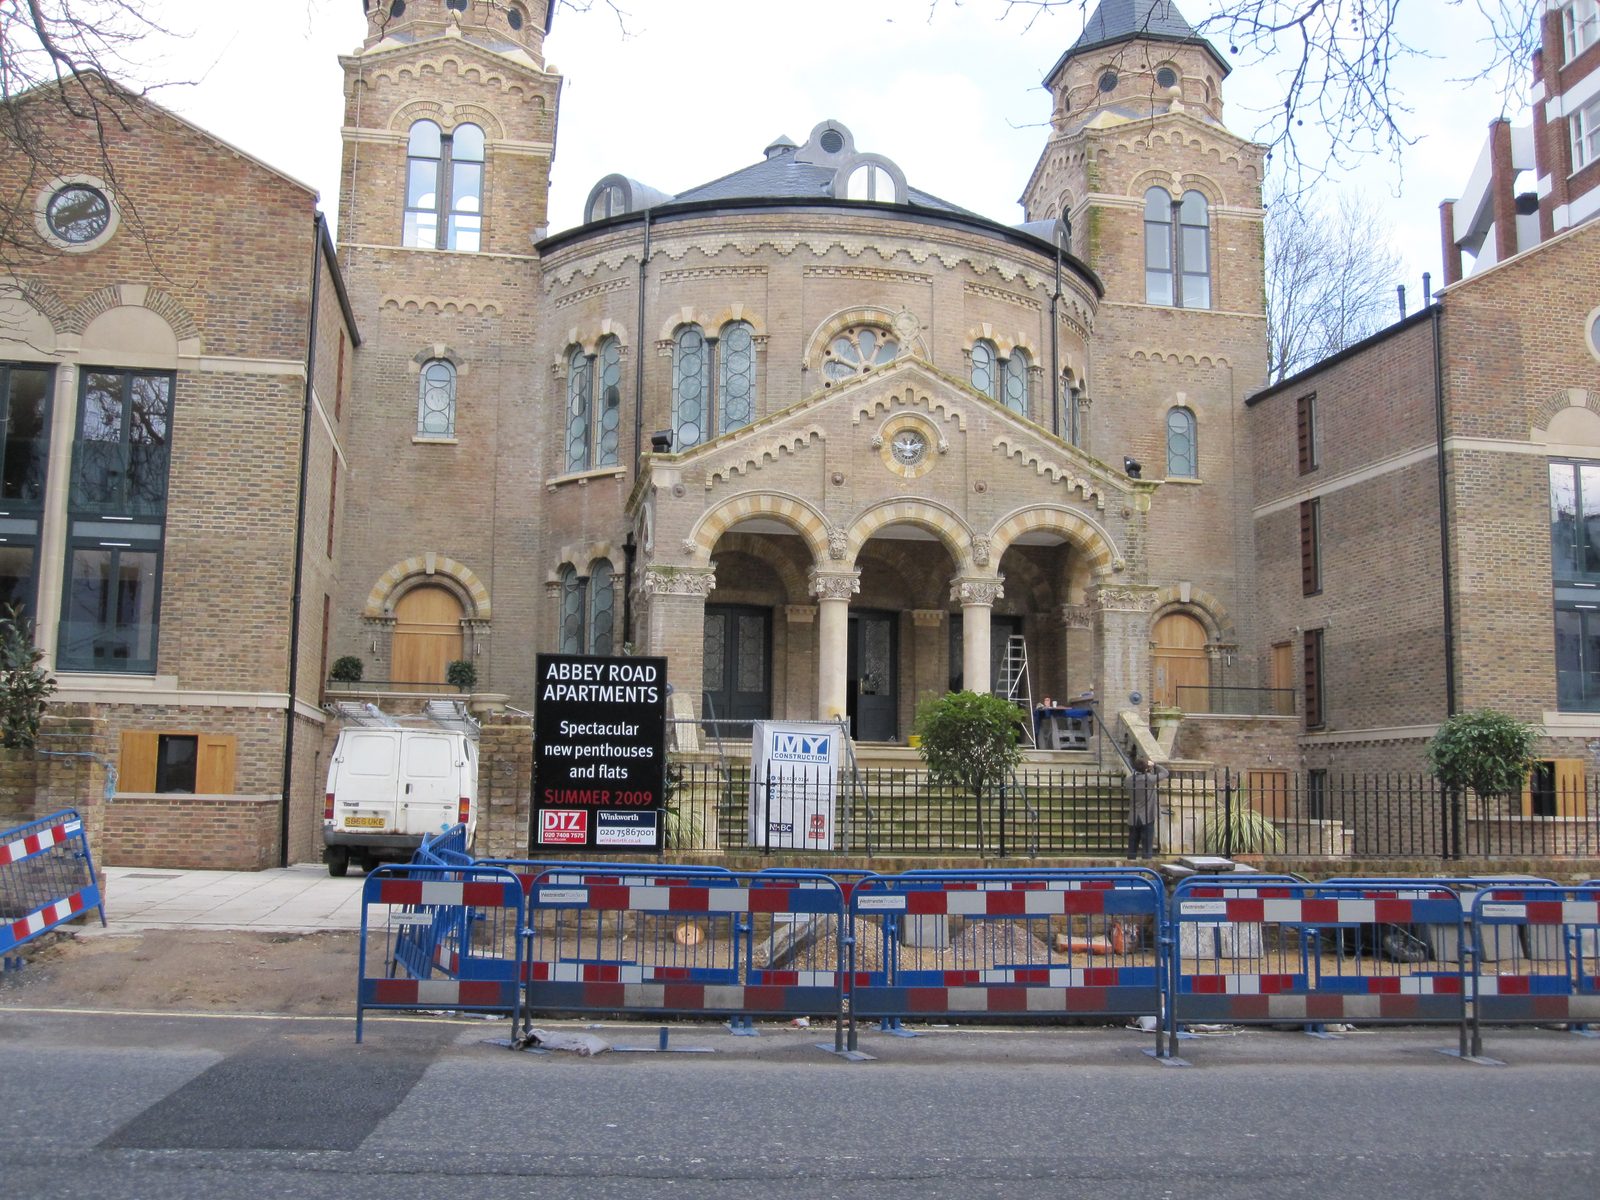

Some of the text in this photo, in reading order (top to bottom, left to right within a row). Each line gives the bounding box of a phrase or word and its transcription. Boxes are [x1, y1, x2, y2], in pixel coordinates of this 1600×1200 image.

[546, 663, 657, 682] ABBEY ROAD
[543, 684, 658, 704] APARTMENTS
[559, 720, 639, 737] Spectacular
[544, 743, 654, 759] new penthouses
[774, 752, 828, 761] CONSTRUCTION
[569, 764, 628, 779] and flats
[544, 789, 653, 806] SUMMER 2009
[544, 812, 580, 830] DTZ
[600, 812, 639, 821] Winkworth
